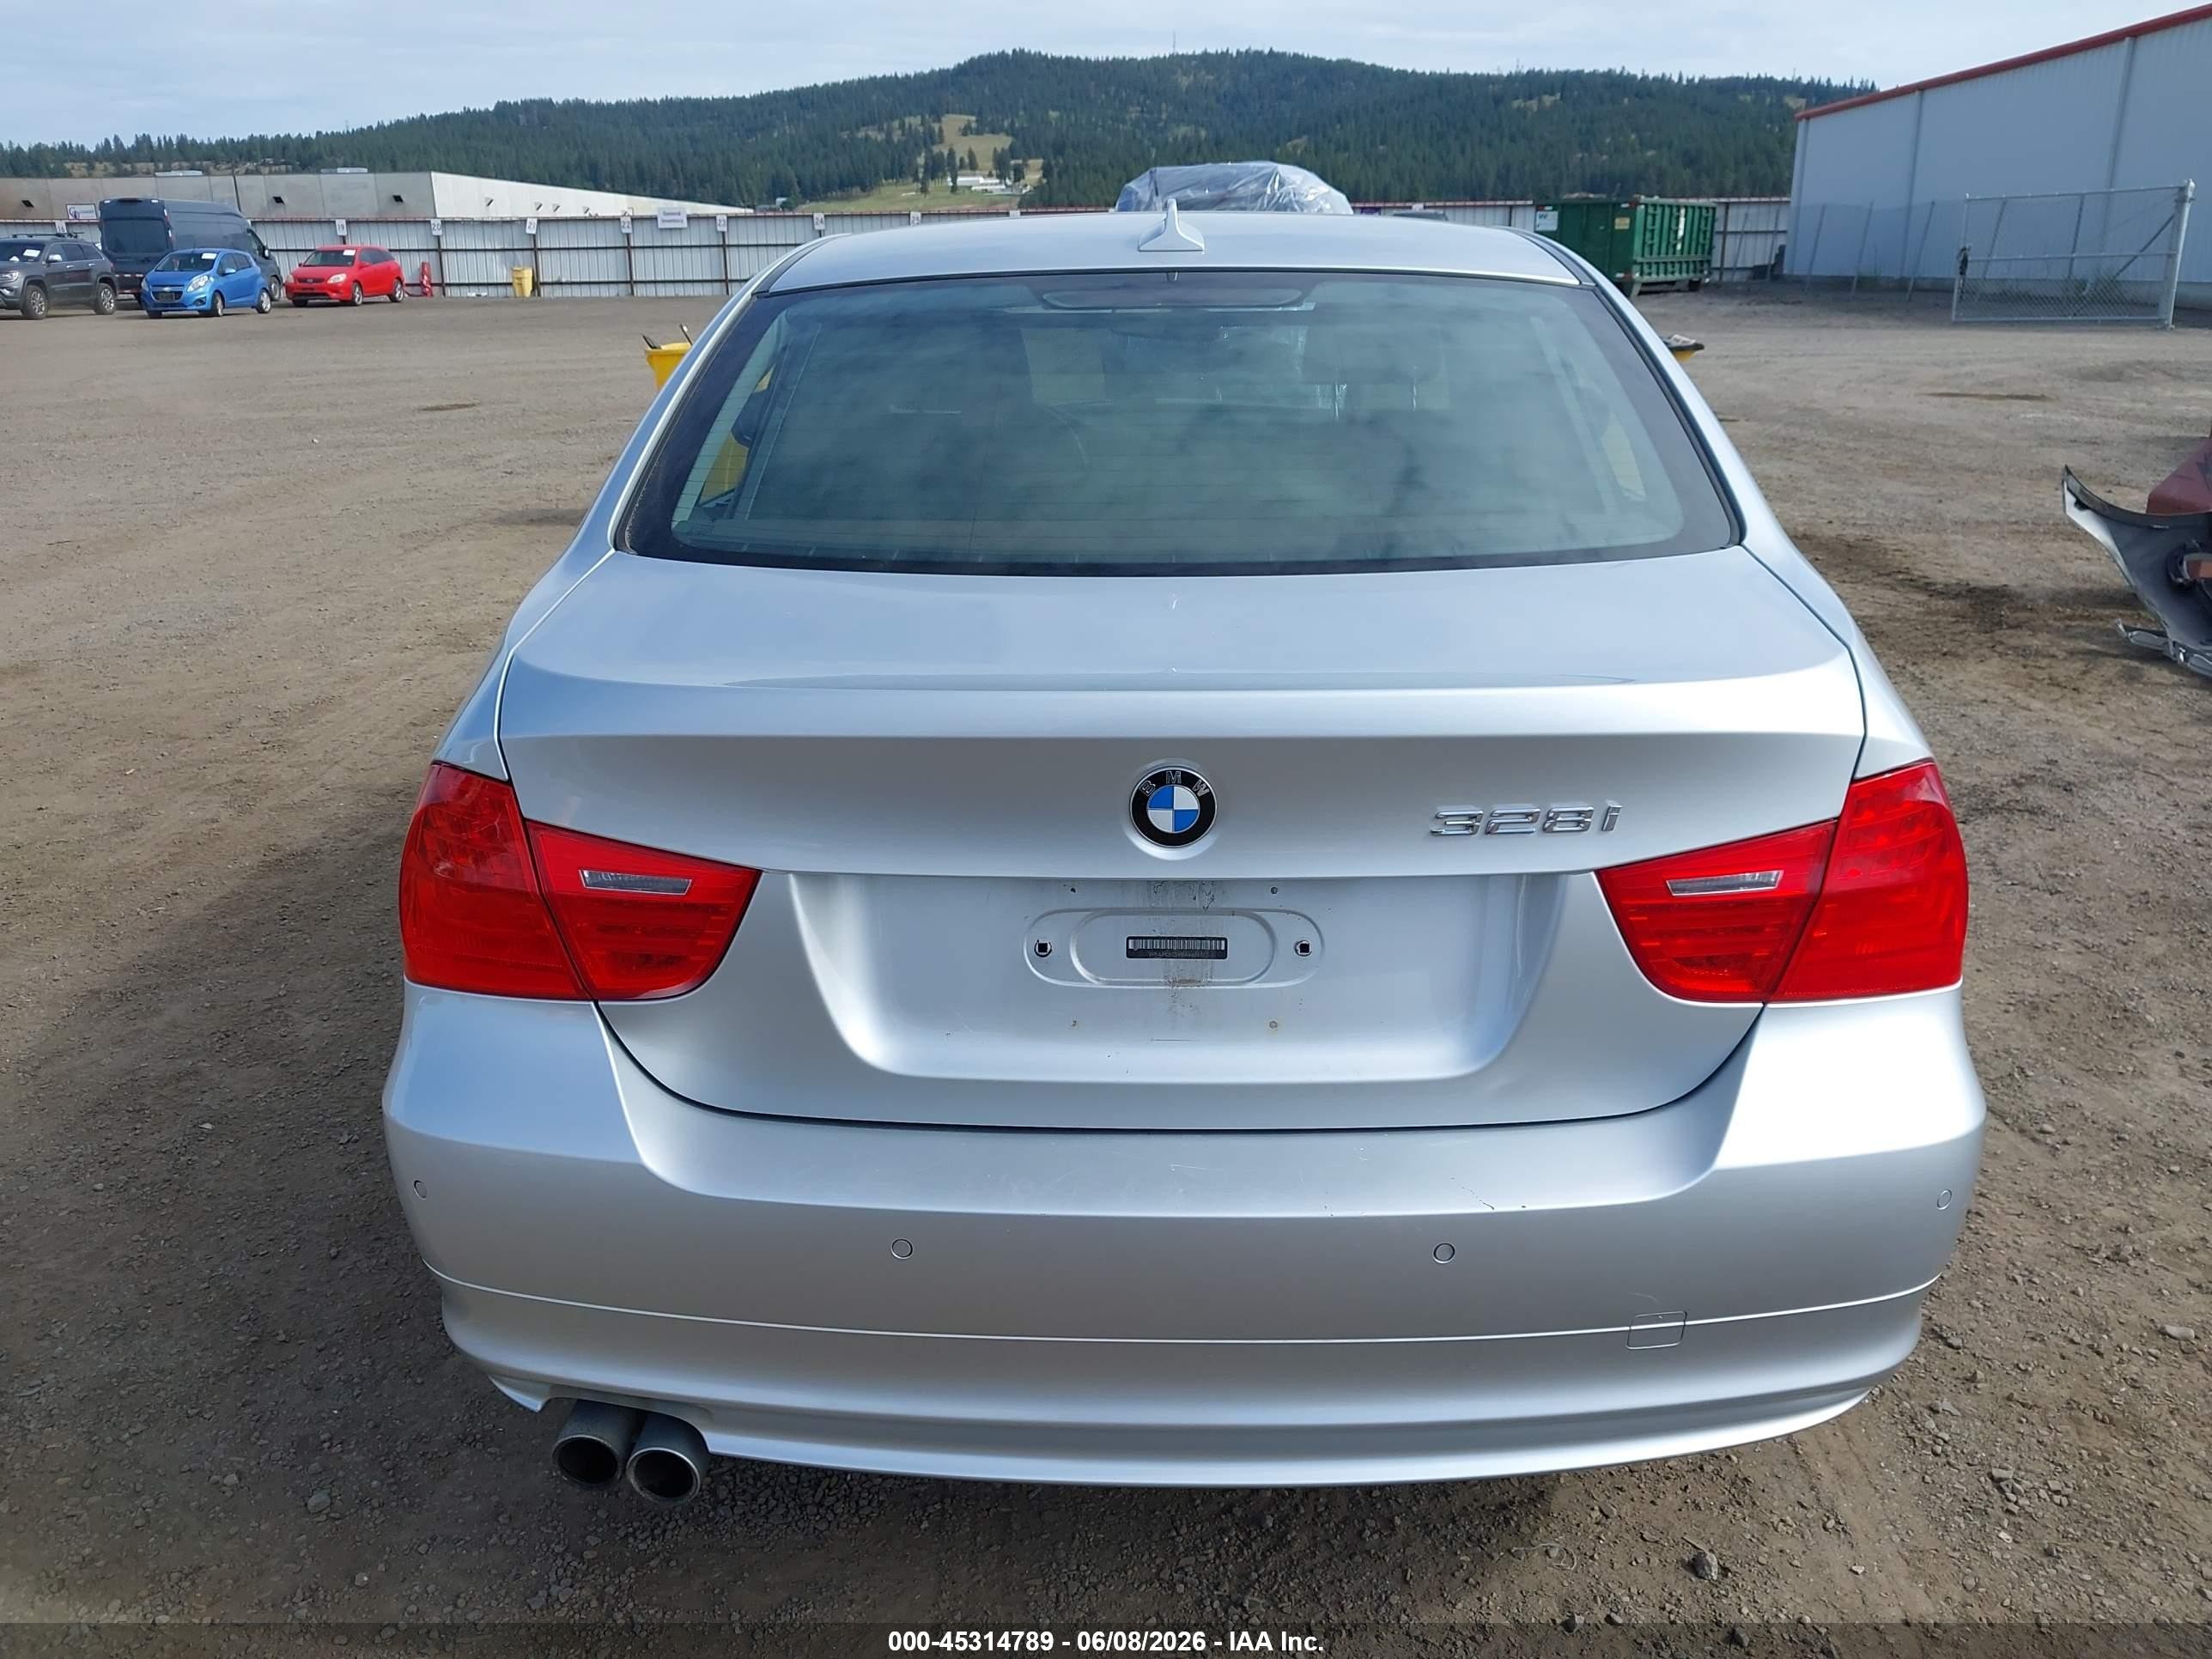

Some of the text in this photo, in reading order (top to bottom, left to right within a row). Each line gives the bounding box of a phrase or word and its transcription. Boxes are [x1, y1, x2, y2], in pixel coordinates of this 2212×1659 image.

[622, 220, 630, 228] 22
[1139, 770, 1210, 797] BMW
[1430, 799, 1622, 836] 328i
